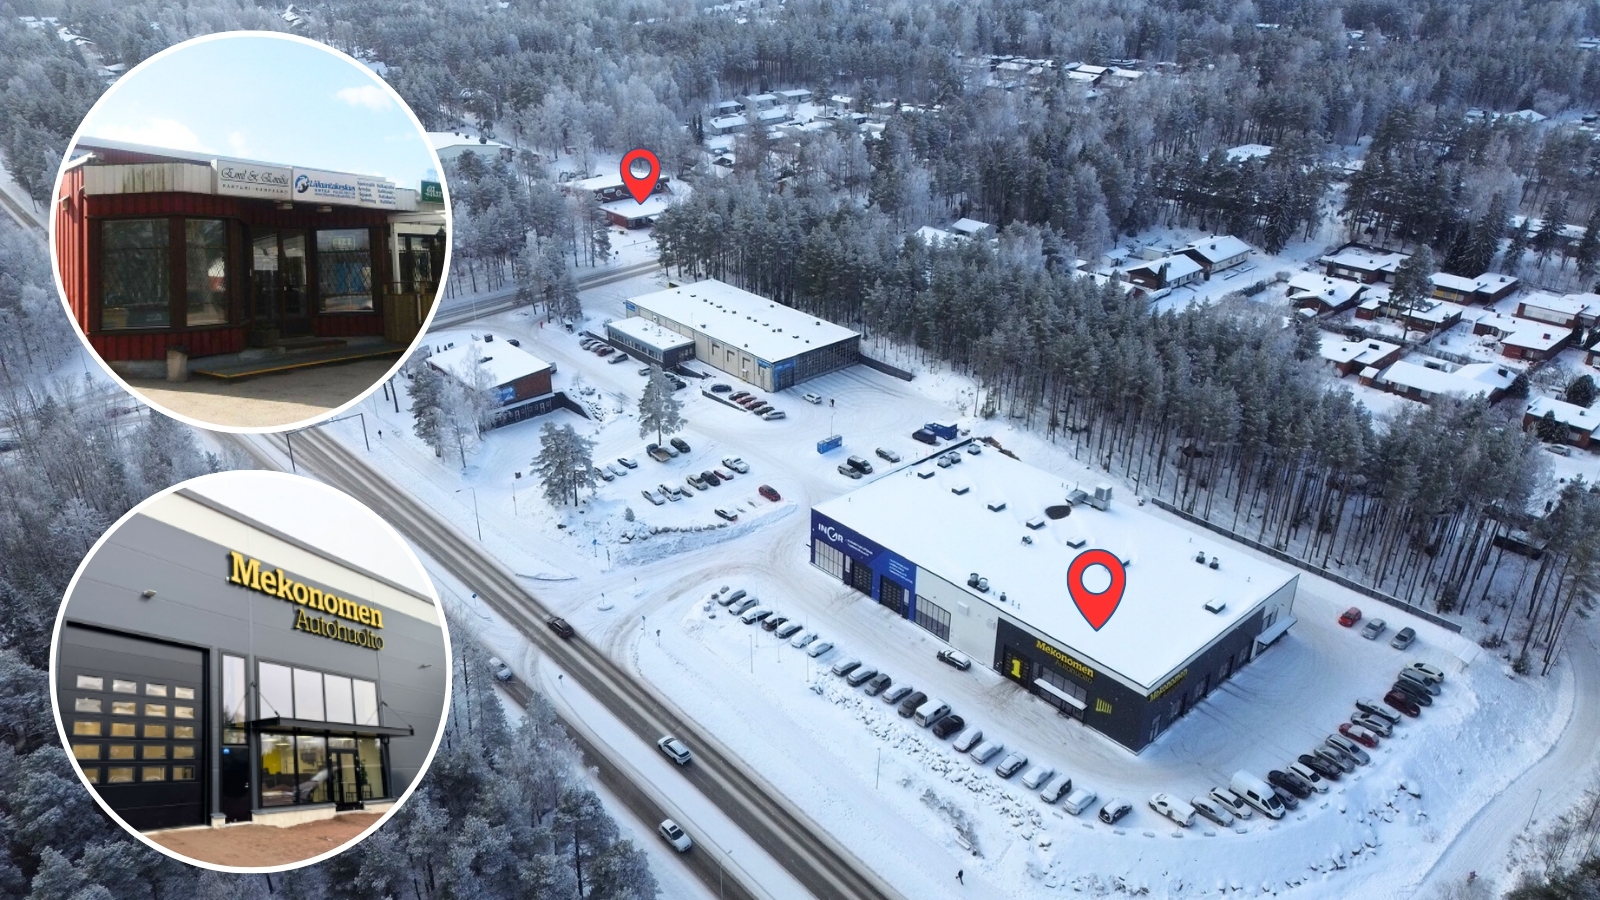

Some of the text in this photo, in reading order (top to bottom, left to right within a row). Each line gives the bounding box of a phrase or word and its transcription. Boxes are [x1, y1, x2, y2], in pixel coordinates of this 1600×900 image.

[230, 550, 384, 629] Mekonomen
[294, 608, 385, 650] Autohuolto
[1011, 659, 1021, 679] 1
[1036, 640, 1095, 678] Mekonomen
